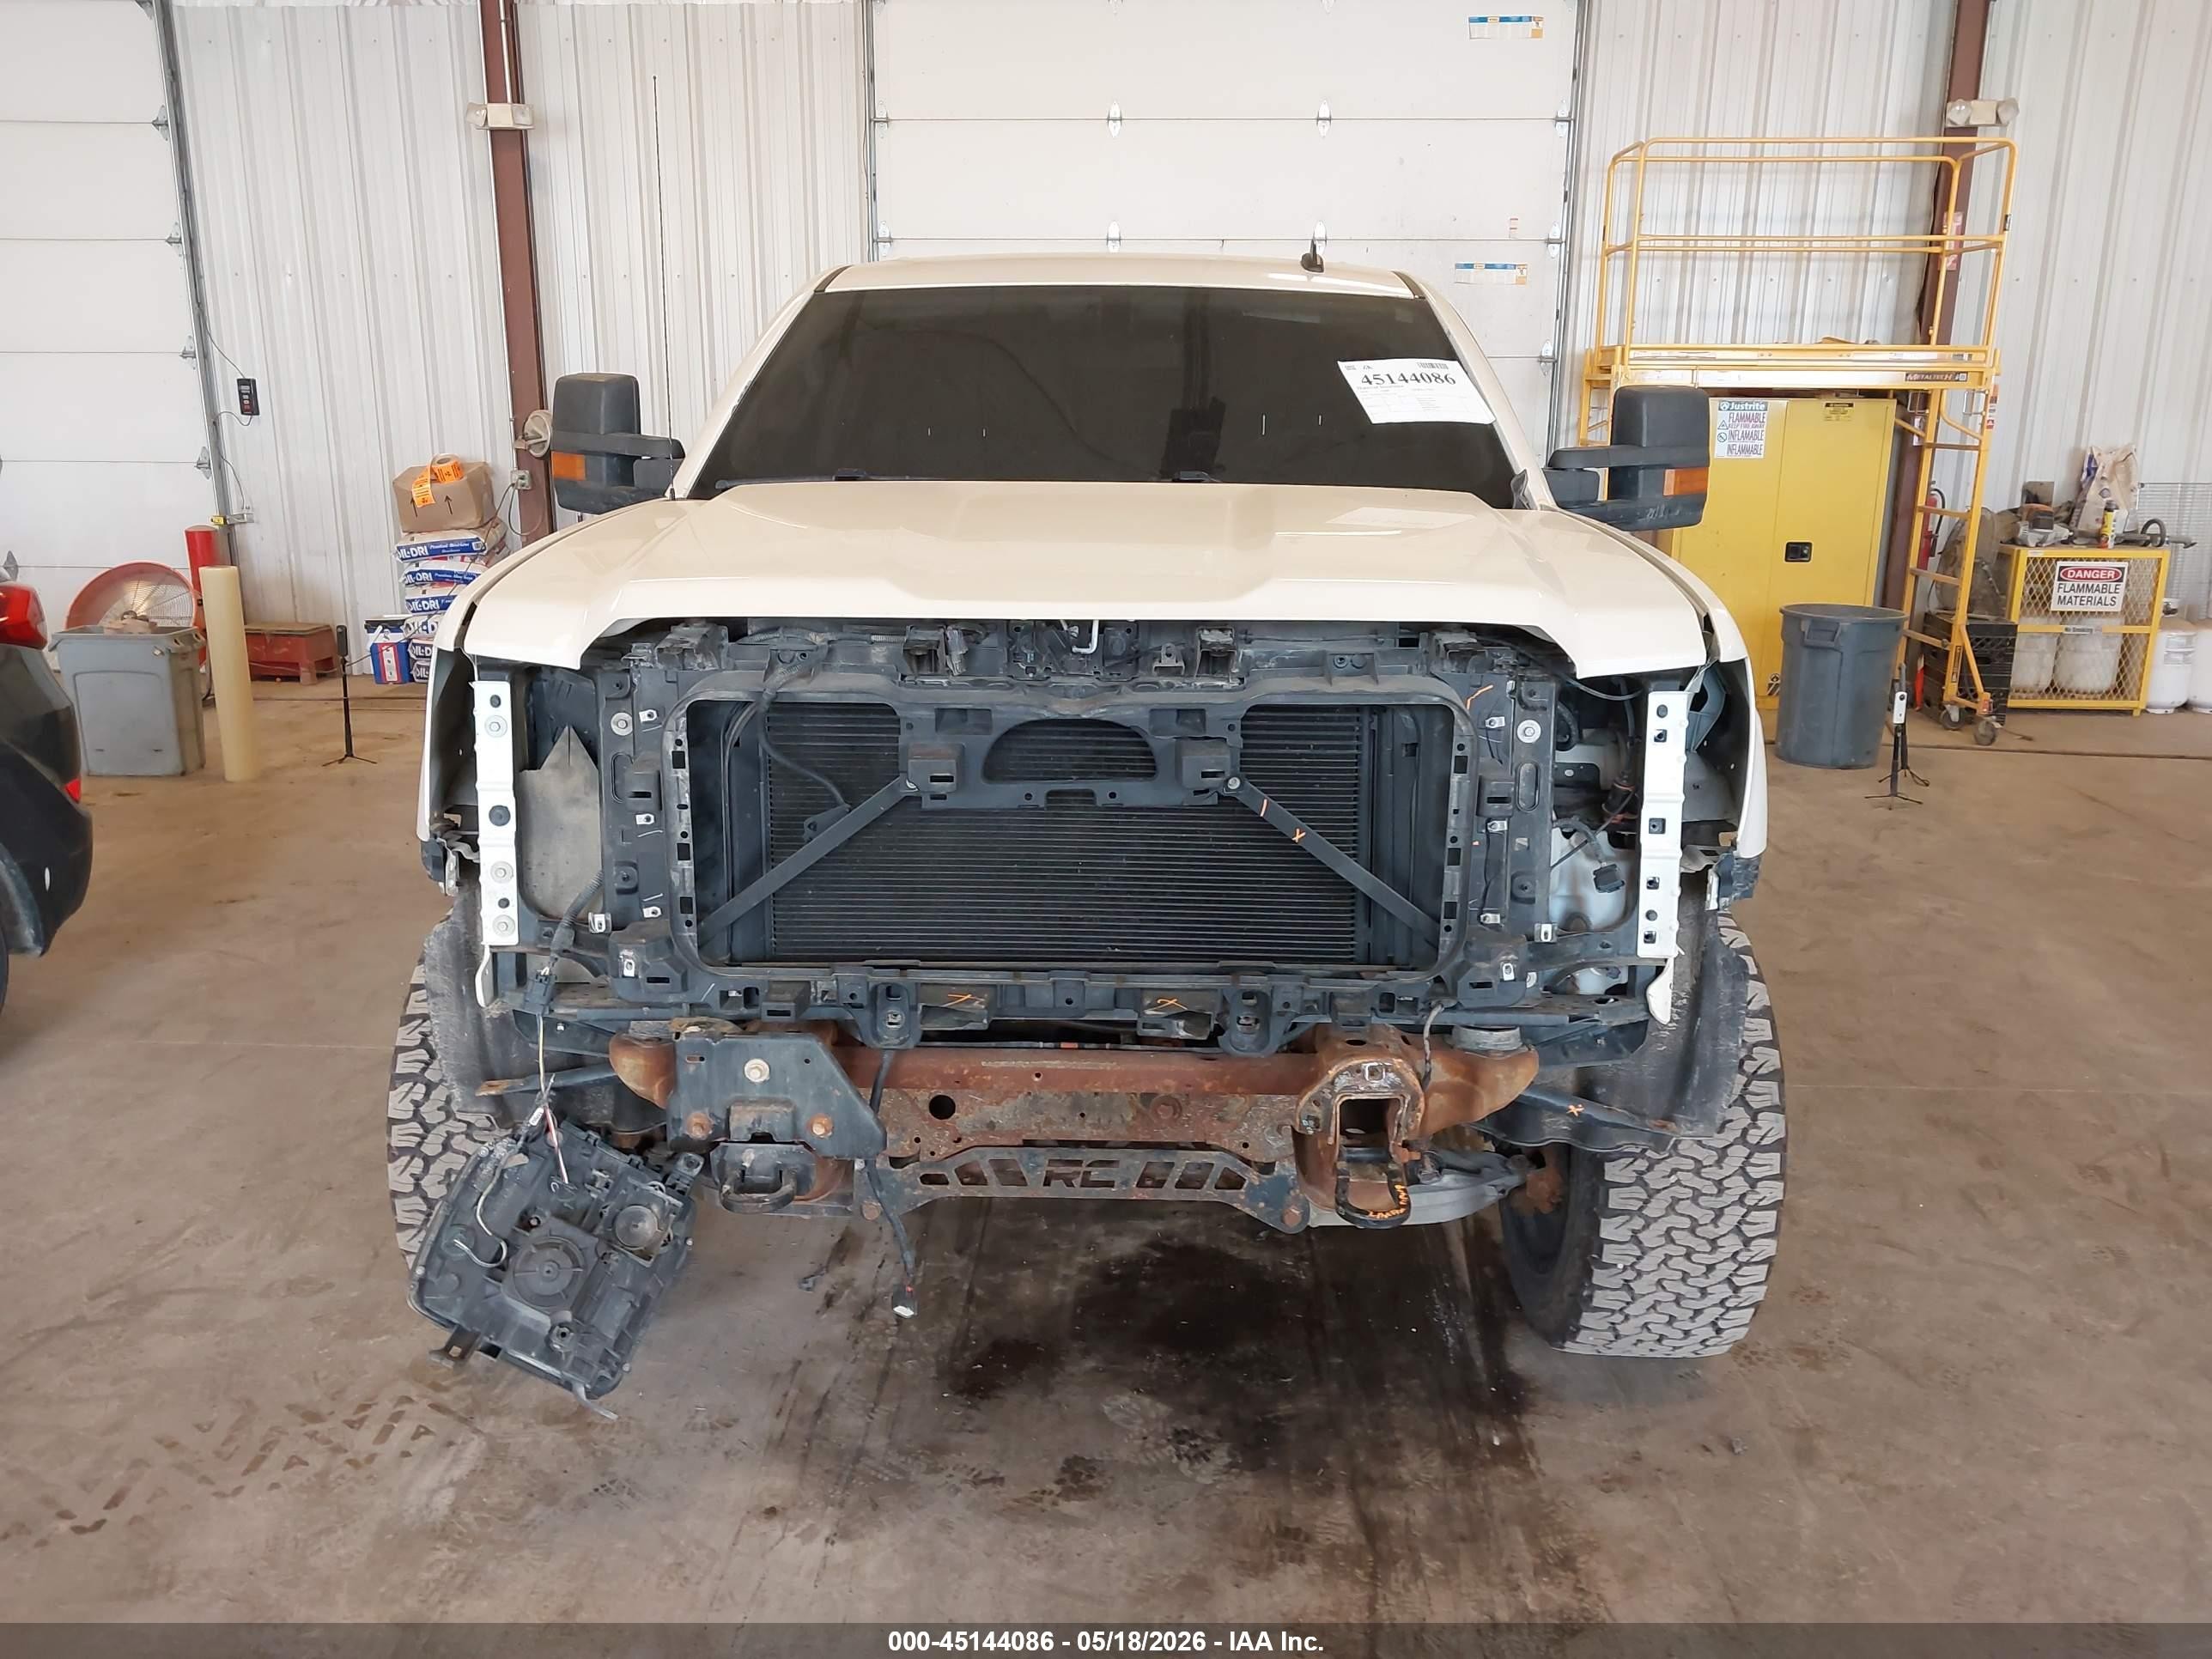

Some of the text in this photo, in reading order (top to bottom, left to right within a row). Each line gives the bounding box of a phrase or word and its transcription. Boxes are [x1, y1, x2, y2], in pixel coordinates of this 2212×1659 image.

[1362, 373, 1456, 385] 45144086
[1730, 402, 1765, 410] Justrite
[1729, 412, 1766, 423] FLAMMABLE
[1728, 429, 1765, 441] INFLAMABLE
[1727, 444, 1763, 455] INFLAMMABLE
[2067, 569, 2116, 579] DANGER
[2057, 583, 2121, 594] FLAMMABLE
[2057, 595, 2117, 606] MATERIALS
[1042, 1159, 1120, 1188] RC
